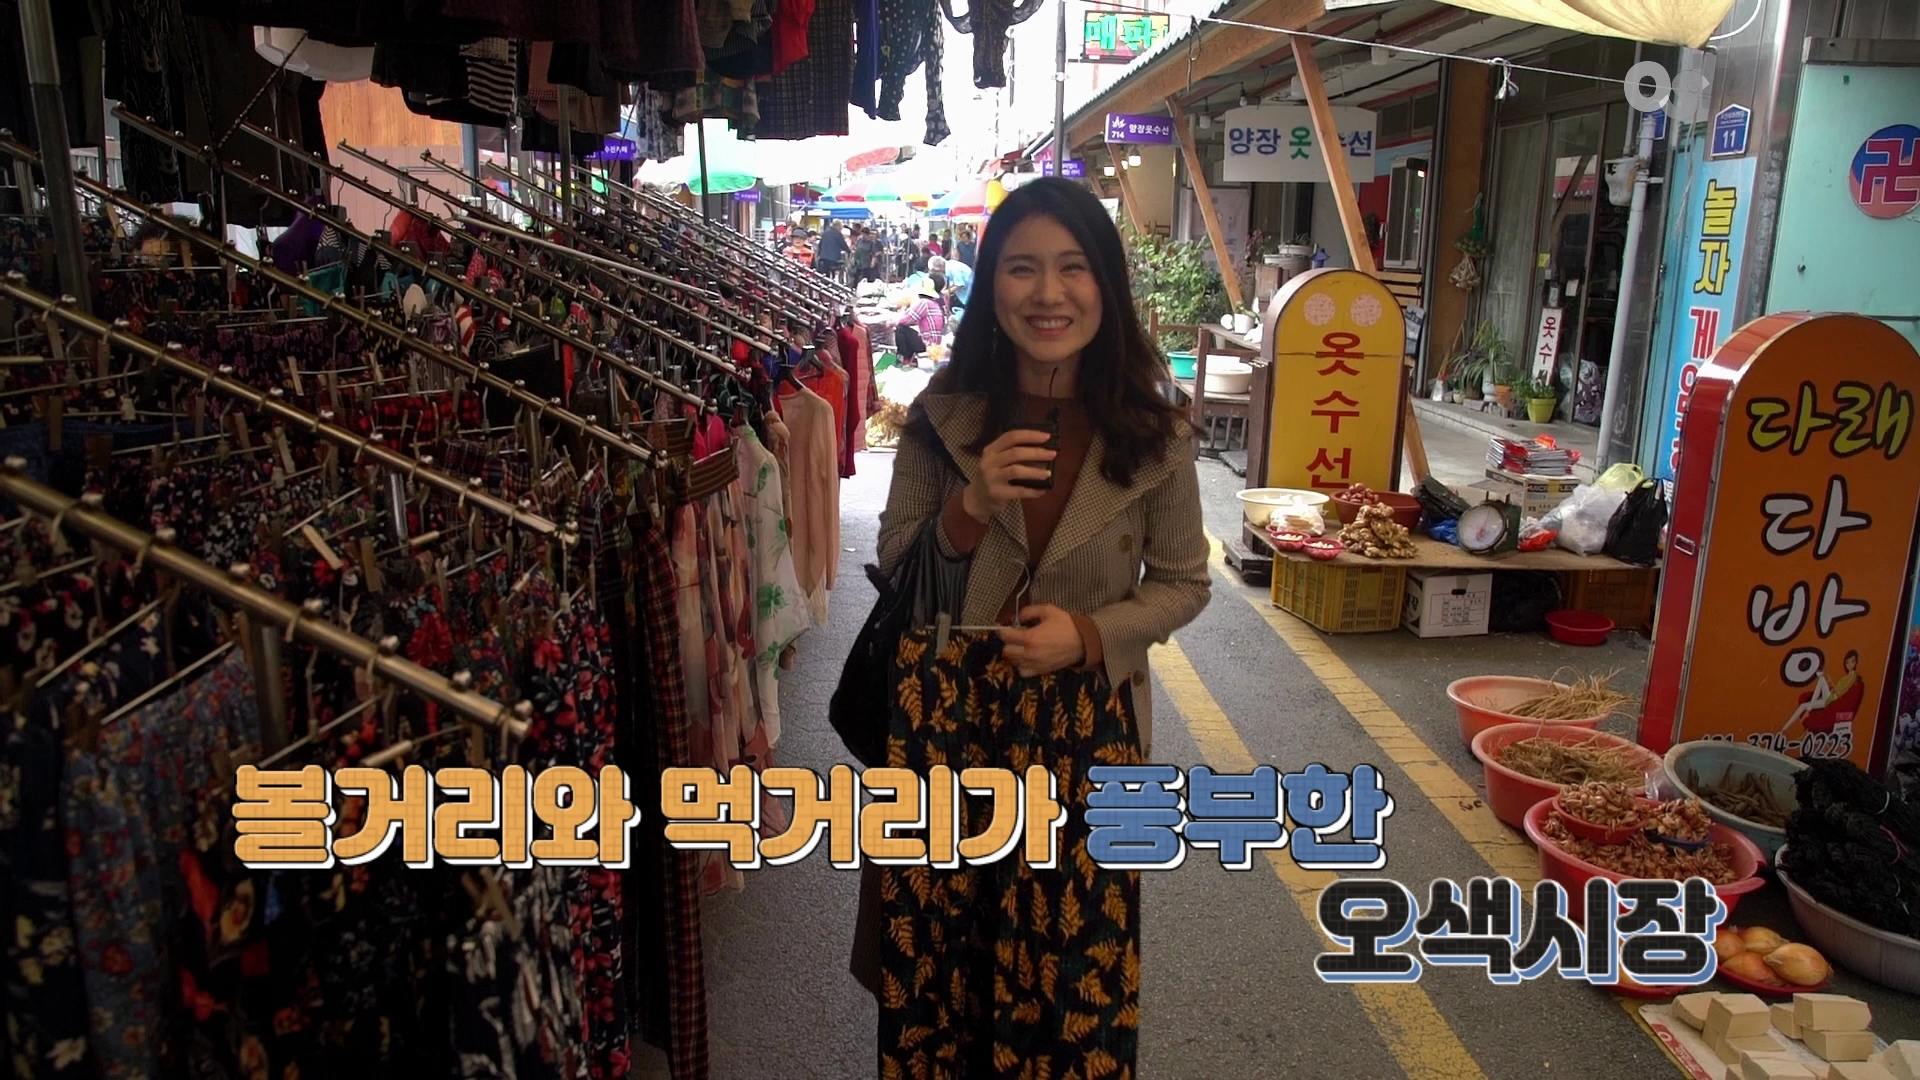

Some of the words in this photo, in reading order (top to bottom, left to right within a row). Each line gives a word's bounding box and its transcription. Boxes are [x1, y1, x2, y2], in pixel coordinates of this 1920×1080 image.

[1111, 130, 1125, 139] 714
[1128, 123, 1170, 136] 양장옷수선
[1229, 127, 1281, 156] 양장
[1289, 126, 1312, 160] 옷
[1722, 129, 1736, 149] 11
[1693, 178, 1738, 296] 놀자
[1305, 331, 1365, 489] 옷수선
[1747, 380, 1914, 460] 다래
[1748, 474, 1871, 687] 다방
